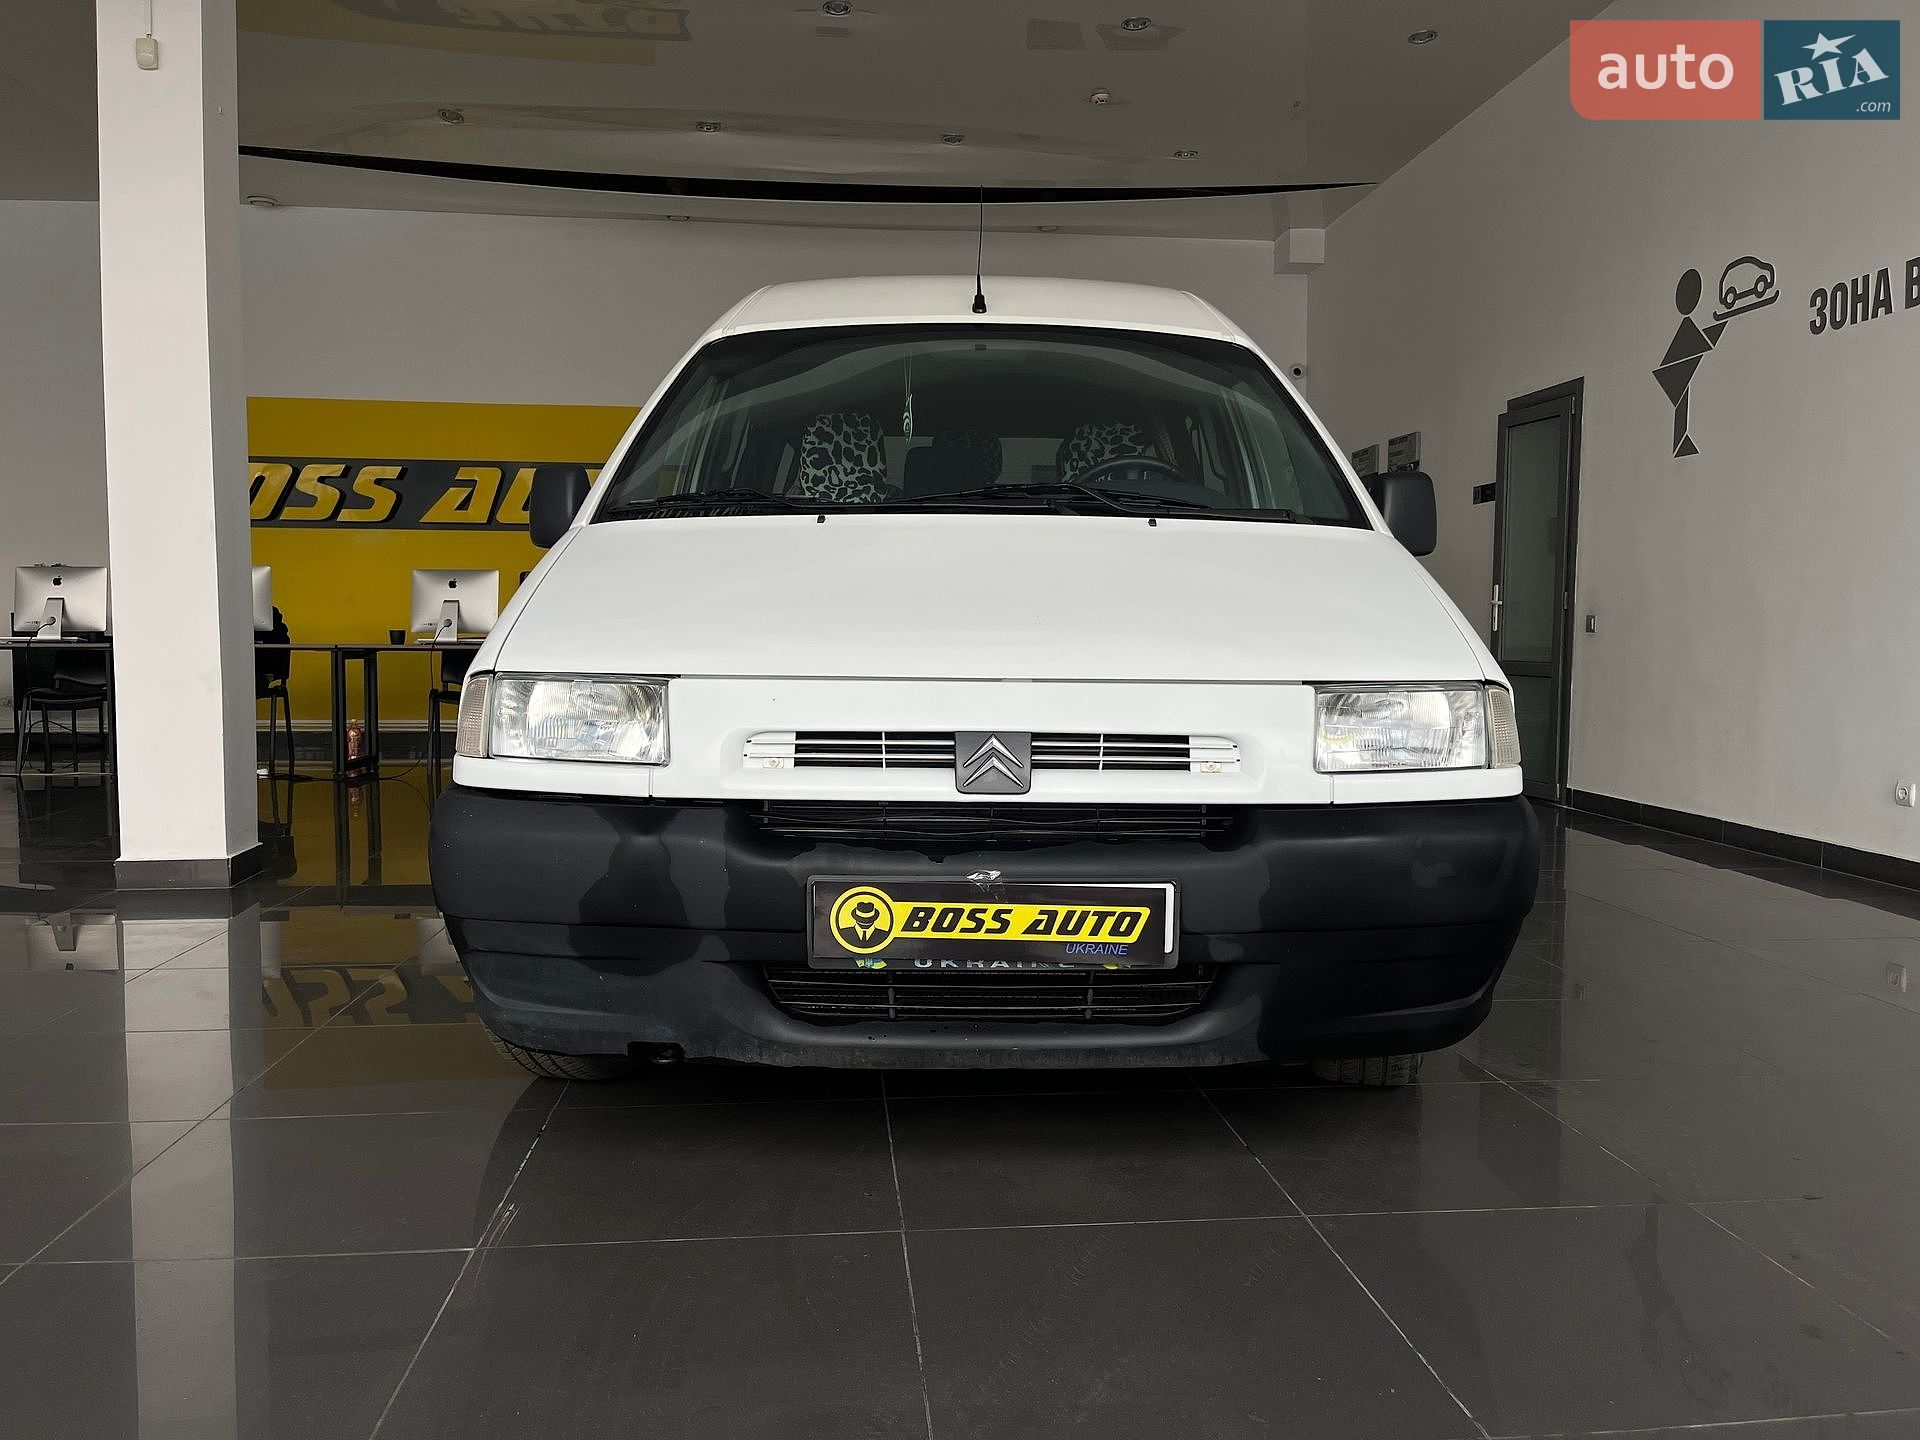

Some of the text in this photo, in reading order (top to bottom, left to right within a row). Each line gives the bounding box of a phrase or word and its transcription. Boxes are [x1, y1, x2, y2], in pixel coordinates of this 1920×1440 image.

[1809, 267, 1893, 335] ЗОНА
[247, 462, 403, 522] OSS
[900, 906, 1142, 938] BOSS AUTO
[1065, 943, 1129, 956] UKRAINE
